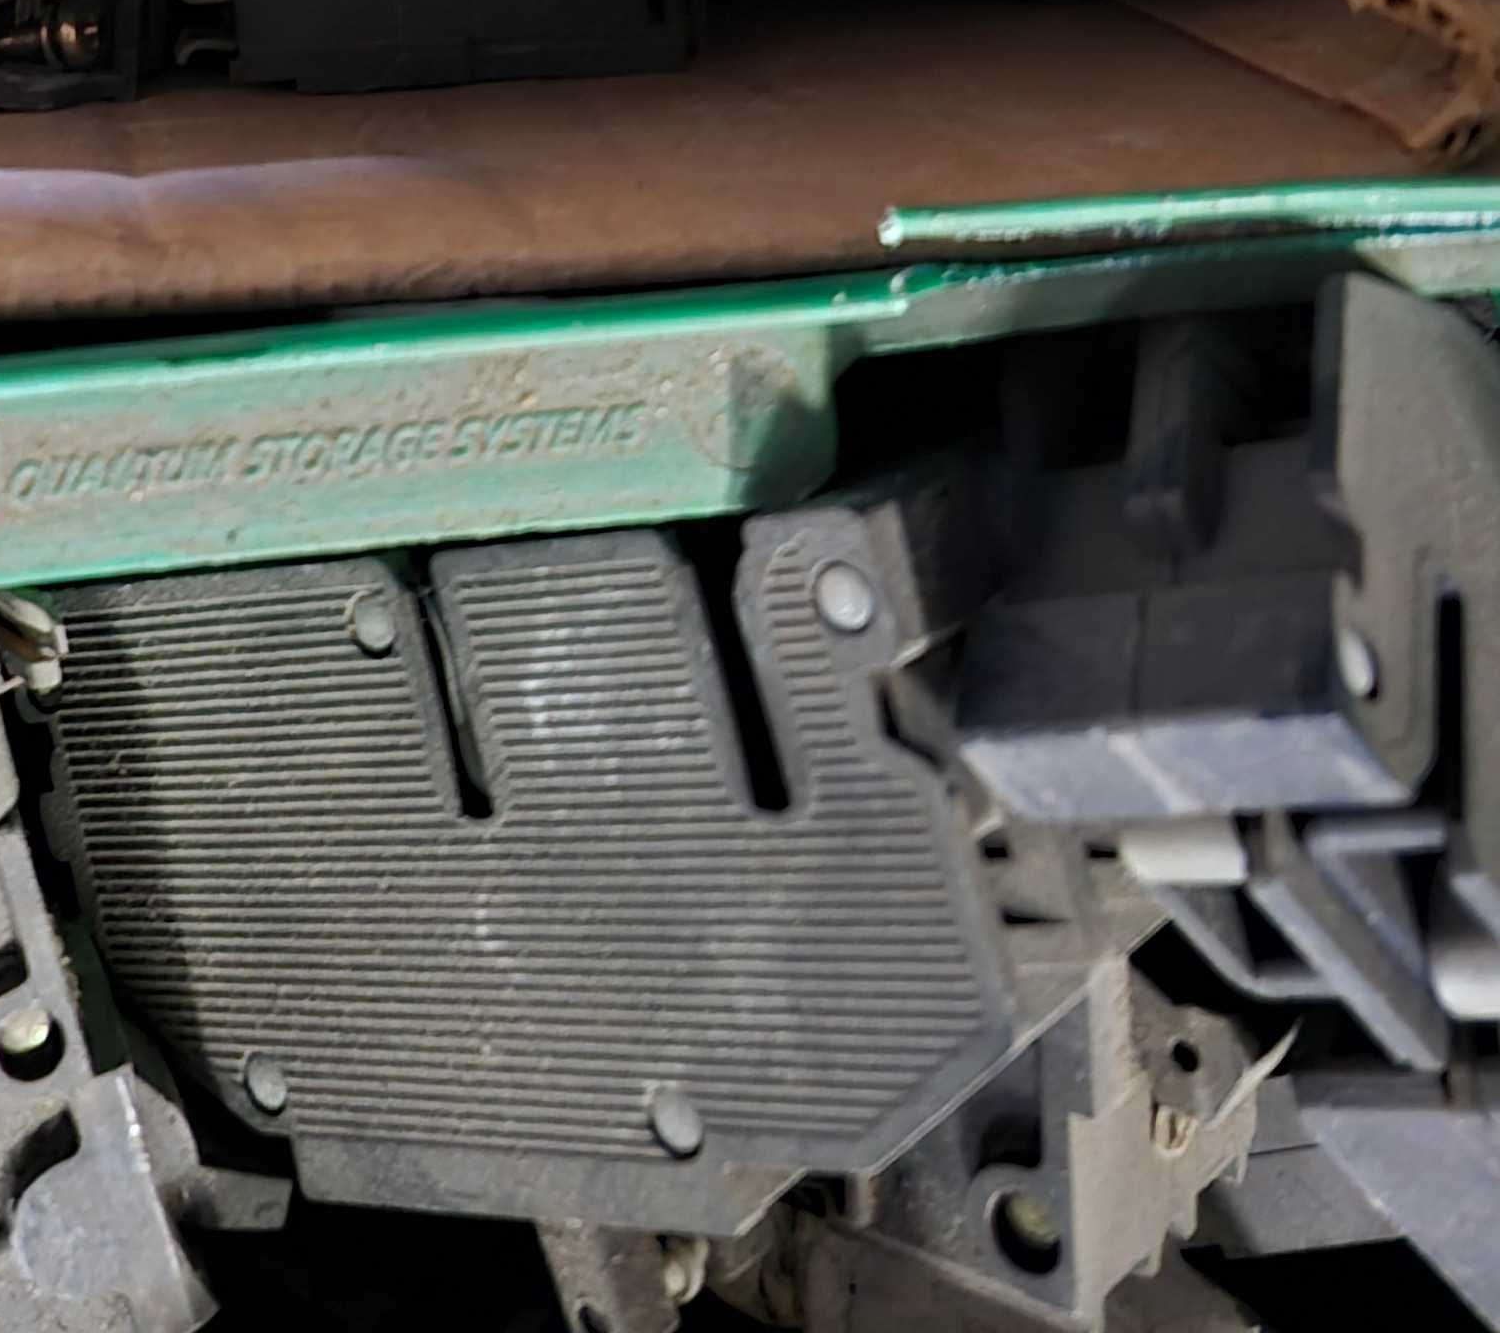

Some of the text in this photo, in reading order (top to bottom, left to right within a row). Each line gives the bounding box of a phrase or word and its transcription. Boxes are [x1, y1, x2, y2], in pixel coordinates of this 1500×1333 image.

[7, 400, 646, 501] QUANTUM STORAGE SYSTEMS
